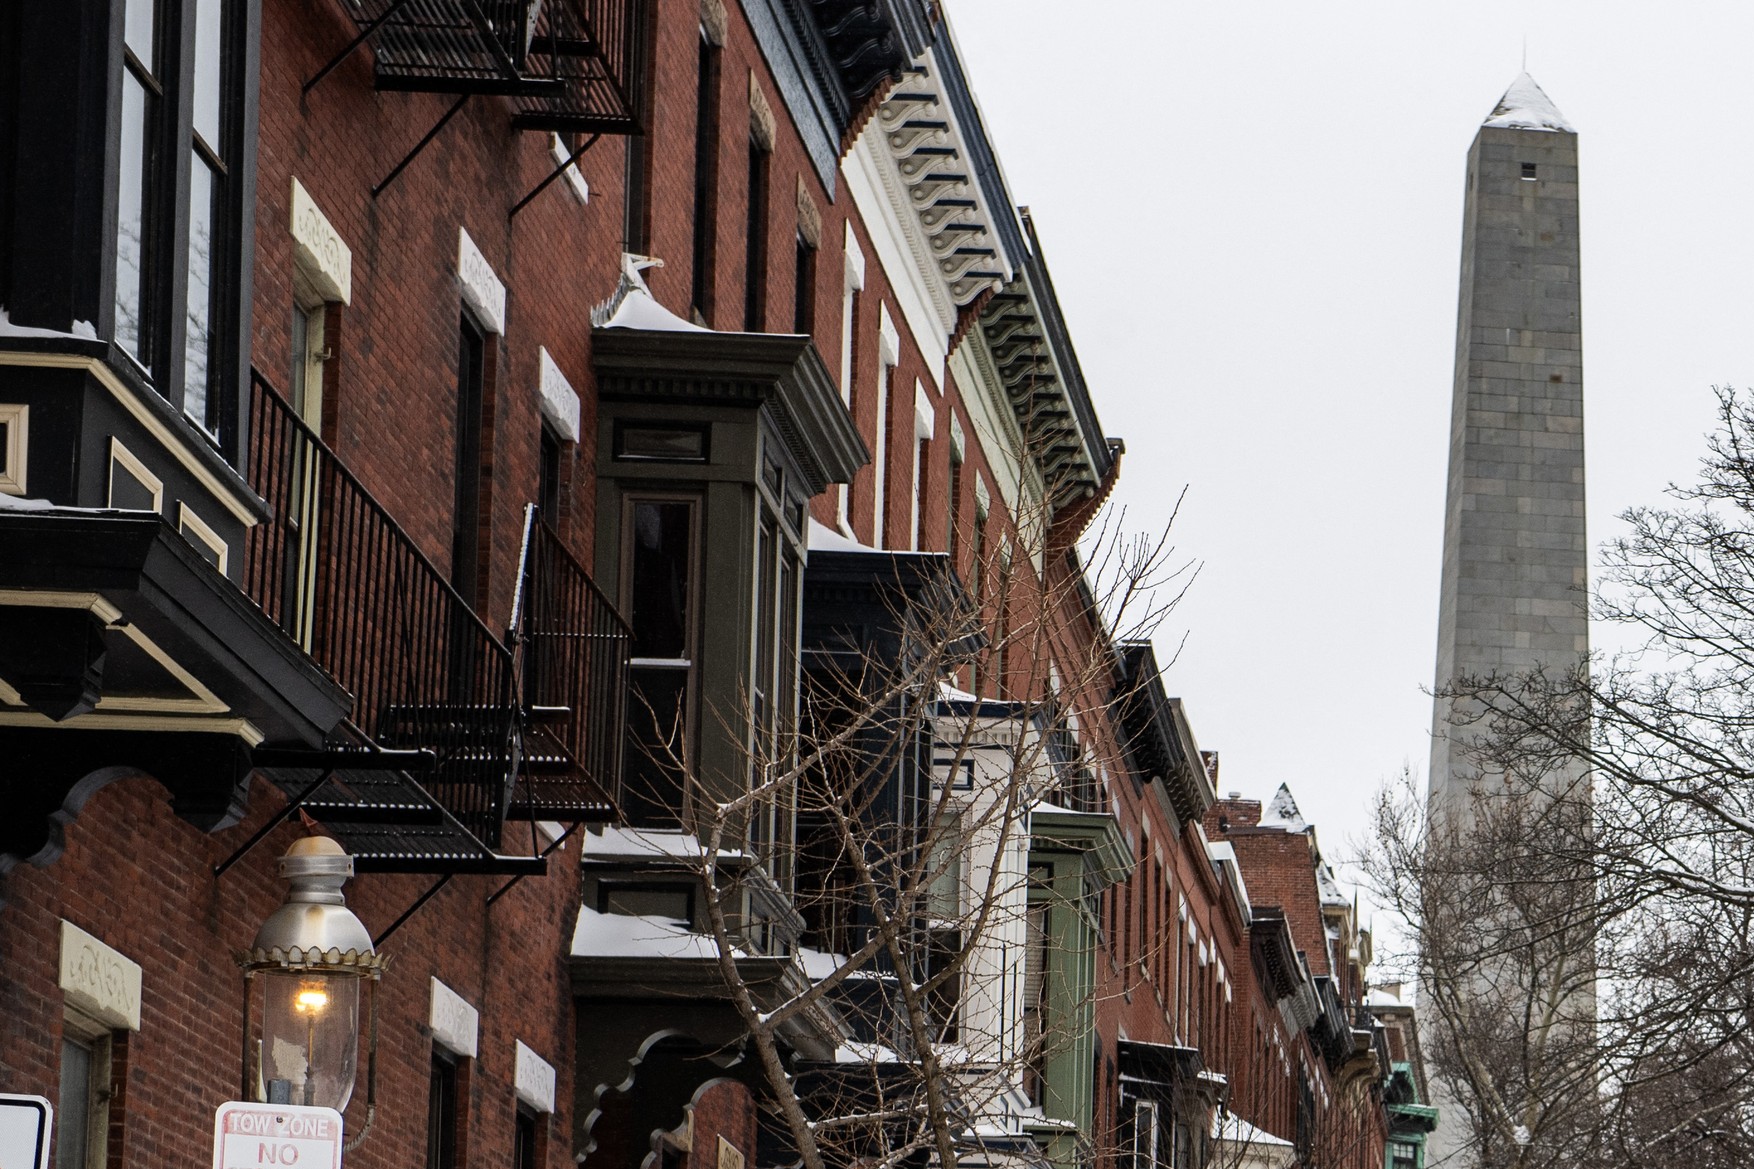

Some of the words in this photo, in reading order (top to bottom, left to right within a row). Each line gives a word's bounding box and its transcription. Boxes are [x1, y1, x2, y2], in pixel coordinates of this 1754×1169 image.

[230, 1113, 270, 1133] TOW
[279, 1116, 328, 1137] ZONE
[258, 1142, 298, 1166] NO
